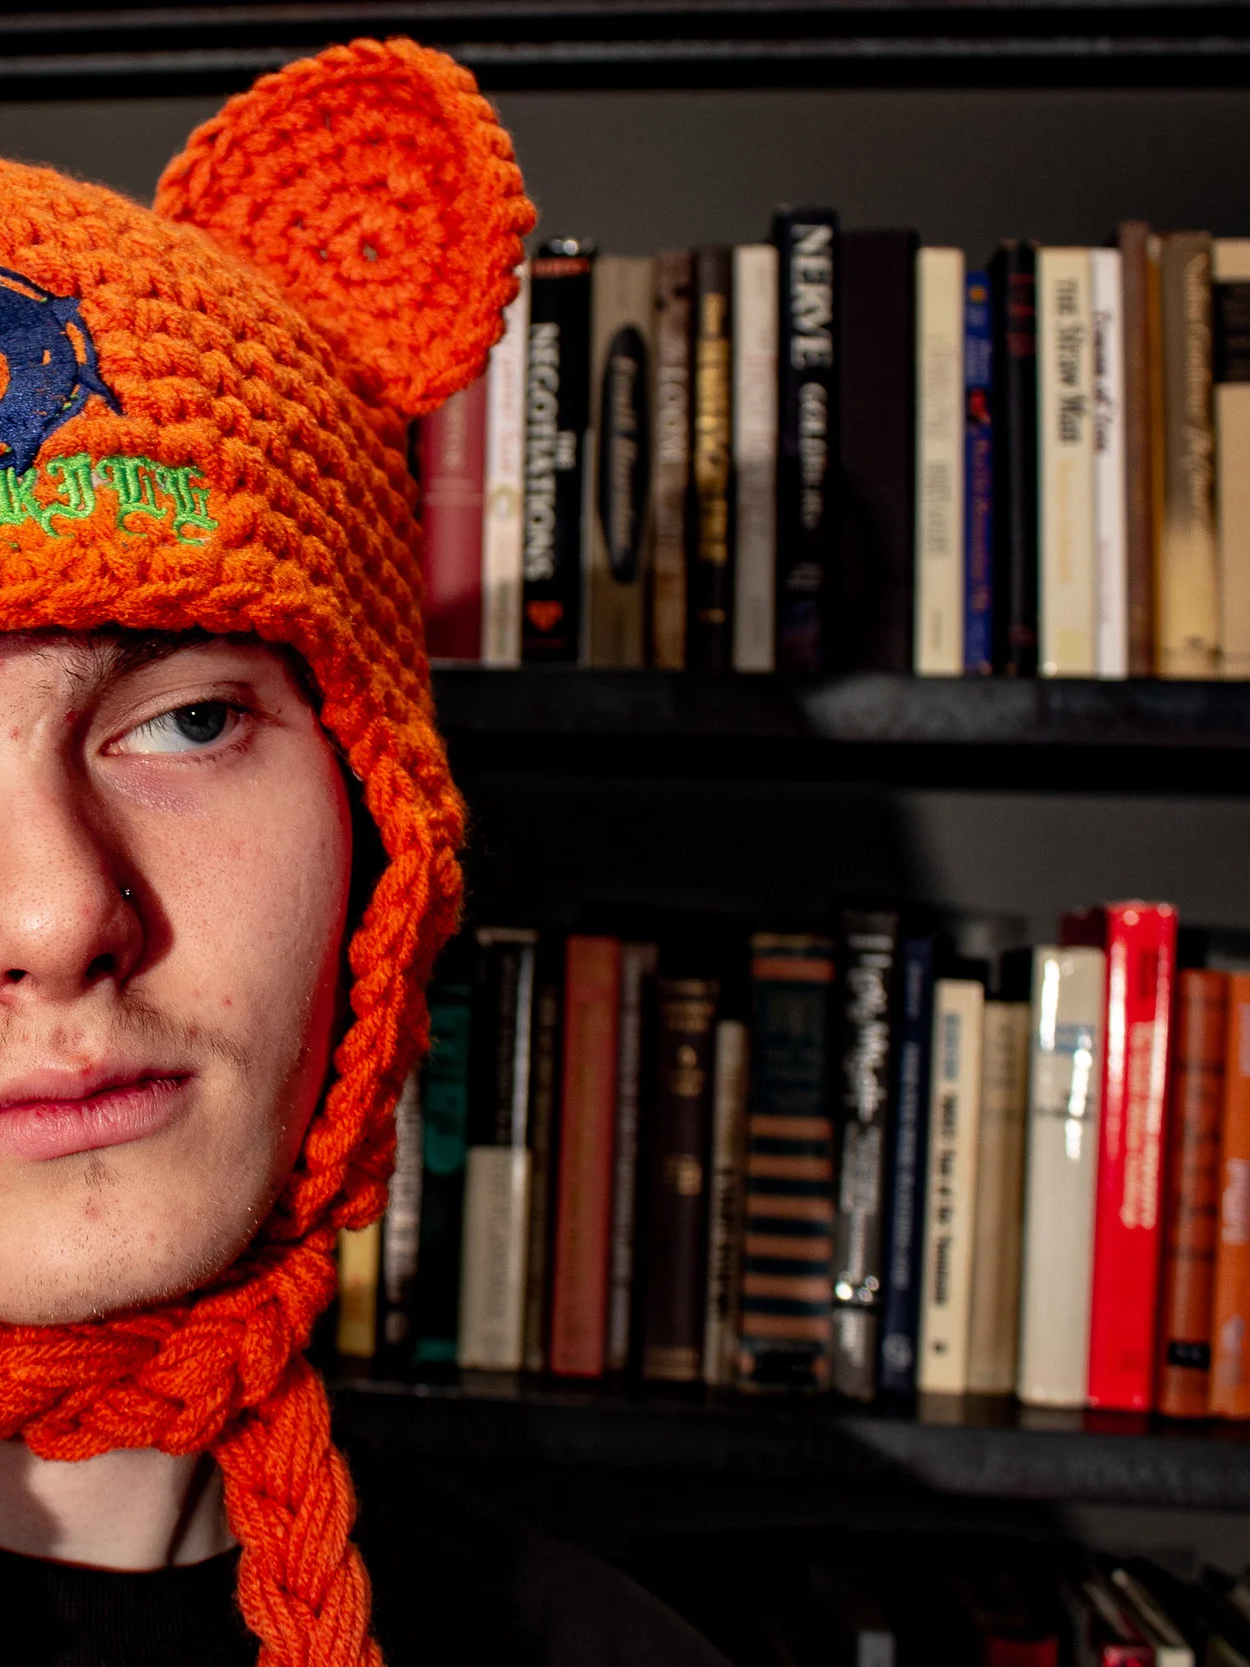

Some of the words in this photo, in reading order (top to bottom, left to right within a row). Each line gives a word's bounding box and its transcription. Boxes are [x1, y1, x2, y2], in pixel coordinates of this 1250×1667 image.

[790, 223, 833, 369] NERVE
[524, 322, 560, 581] NEGOTIATIONS
[557, 430, 575, 470] THE
